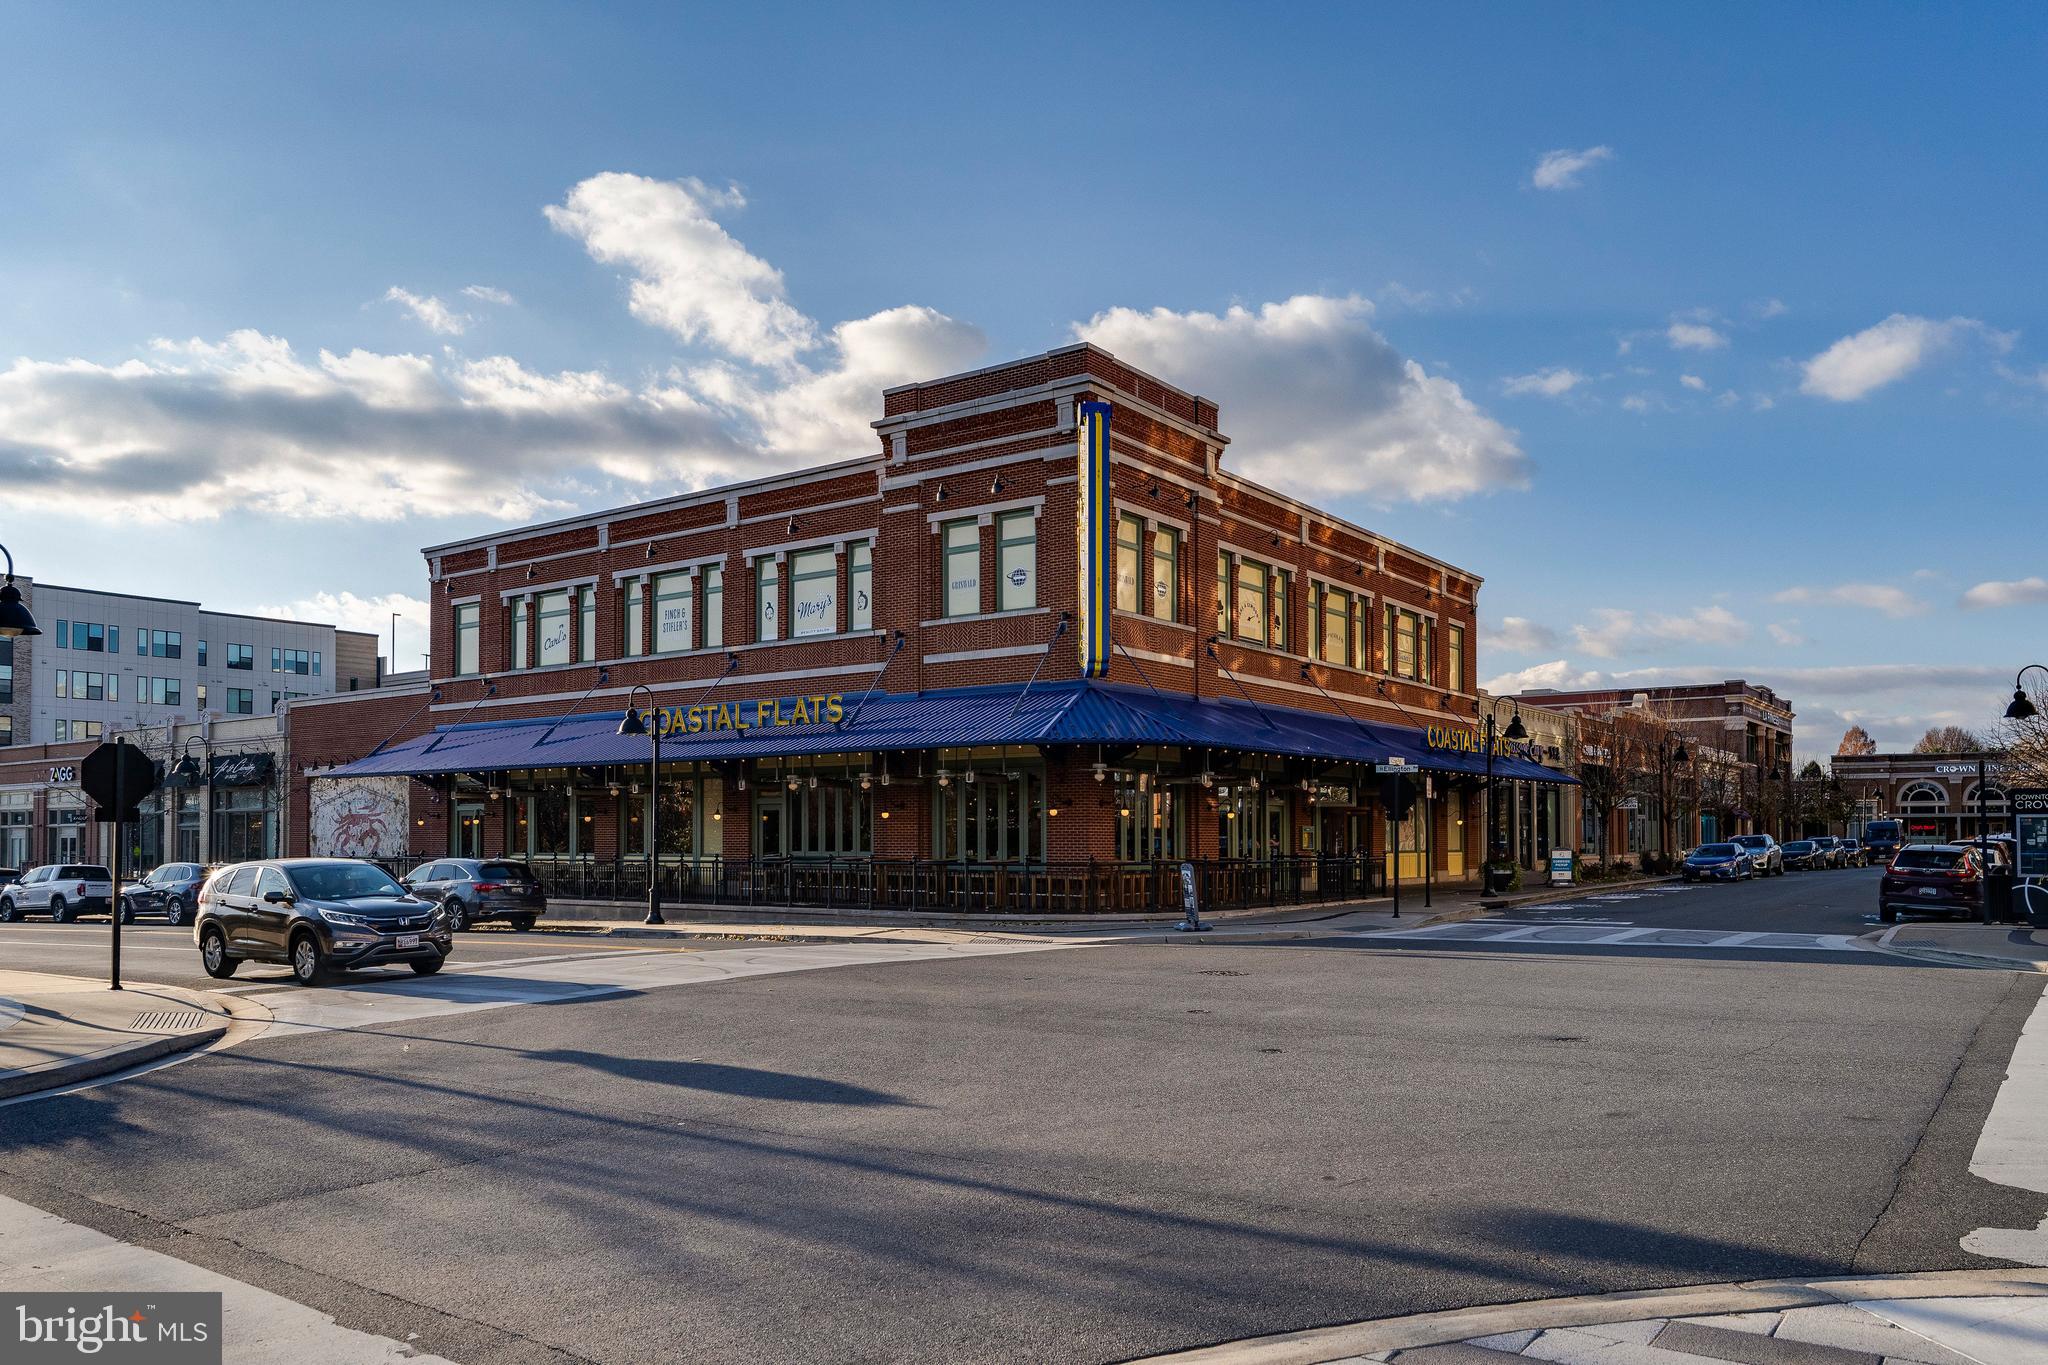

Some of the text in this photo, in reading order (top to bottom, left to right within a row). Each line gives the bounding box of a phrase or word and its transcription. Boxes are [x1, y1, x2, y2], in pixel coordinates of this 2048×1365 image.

[665, 608, 680, 620] FINCH
[797, 594, 832, 619] Mary's
[663, 620, 688, 633] STIFLER'S
[544, 631, 567, 651] Carl's
[758, 694, 843, 727] FLATS
[1427, 726, 1478, 752] COASTAL
[1480, 732, 1510, 757] FATS
[50, 766, 73, 782] ZAGG
[1936, 765, 1976, 773] CROWN
